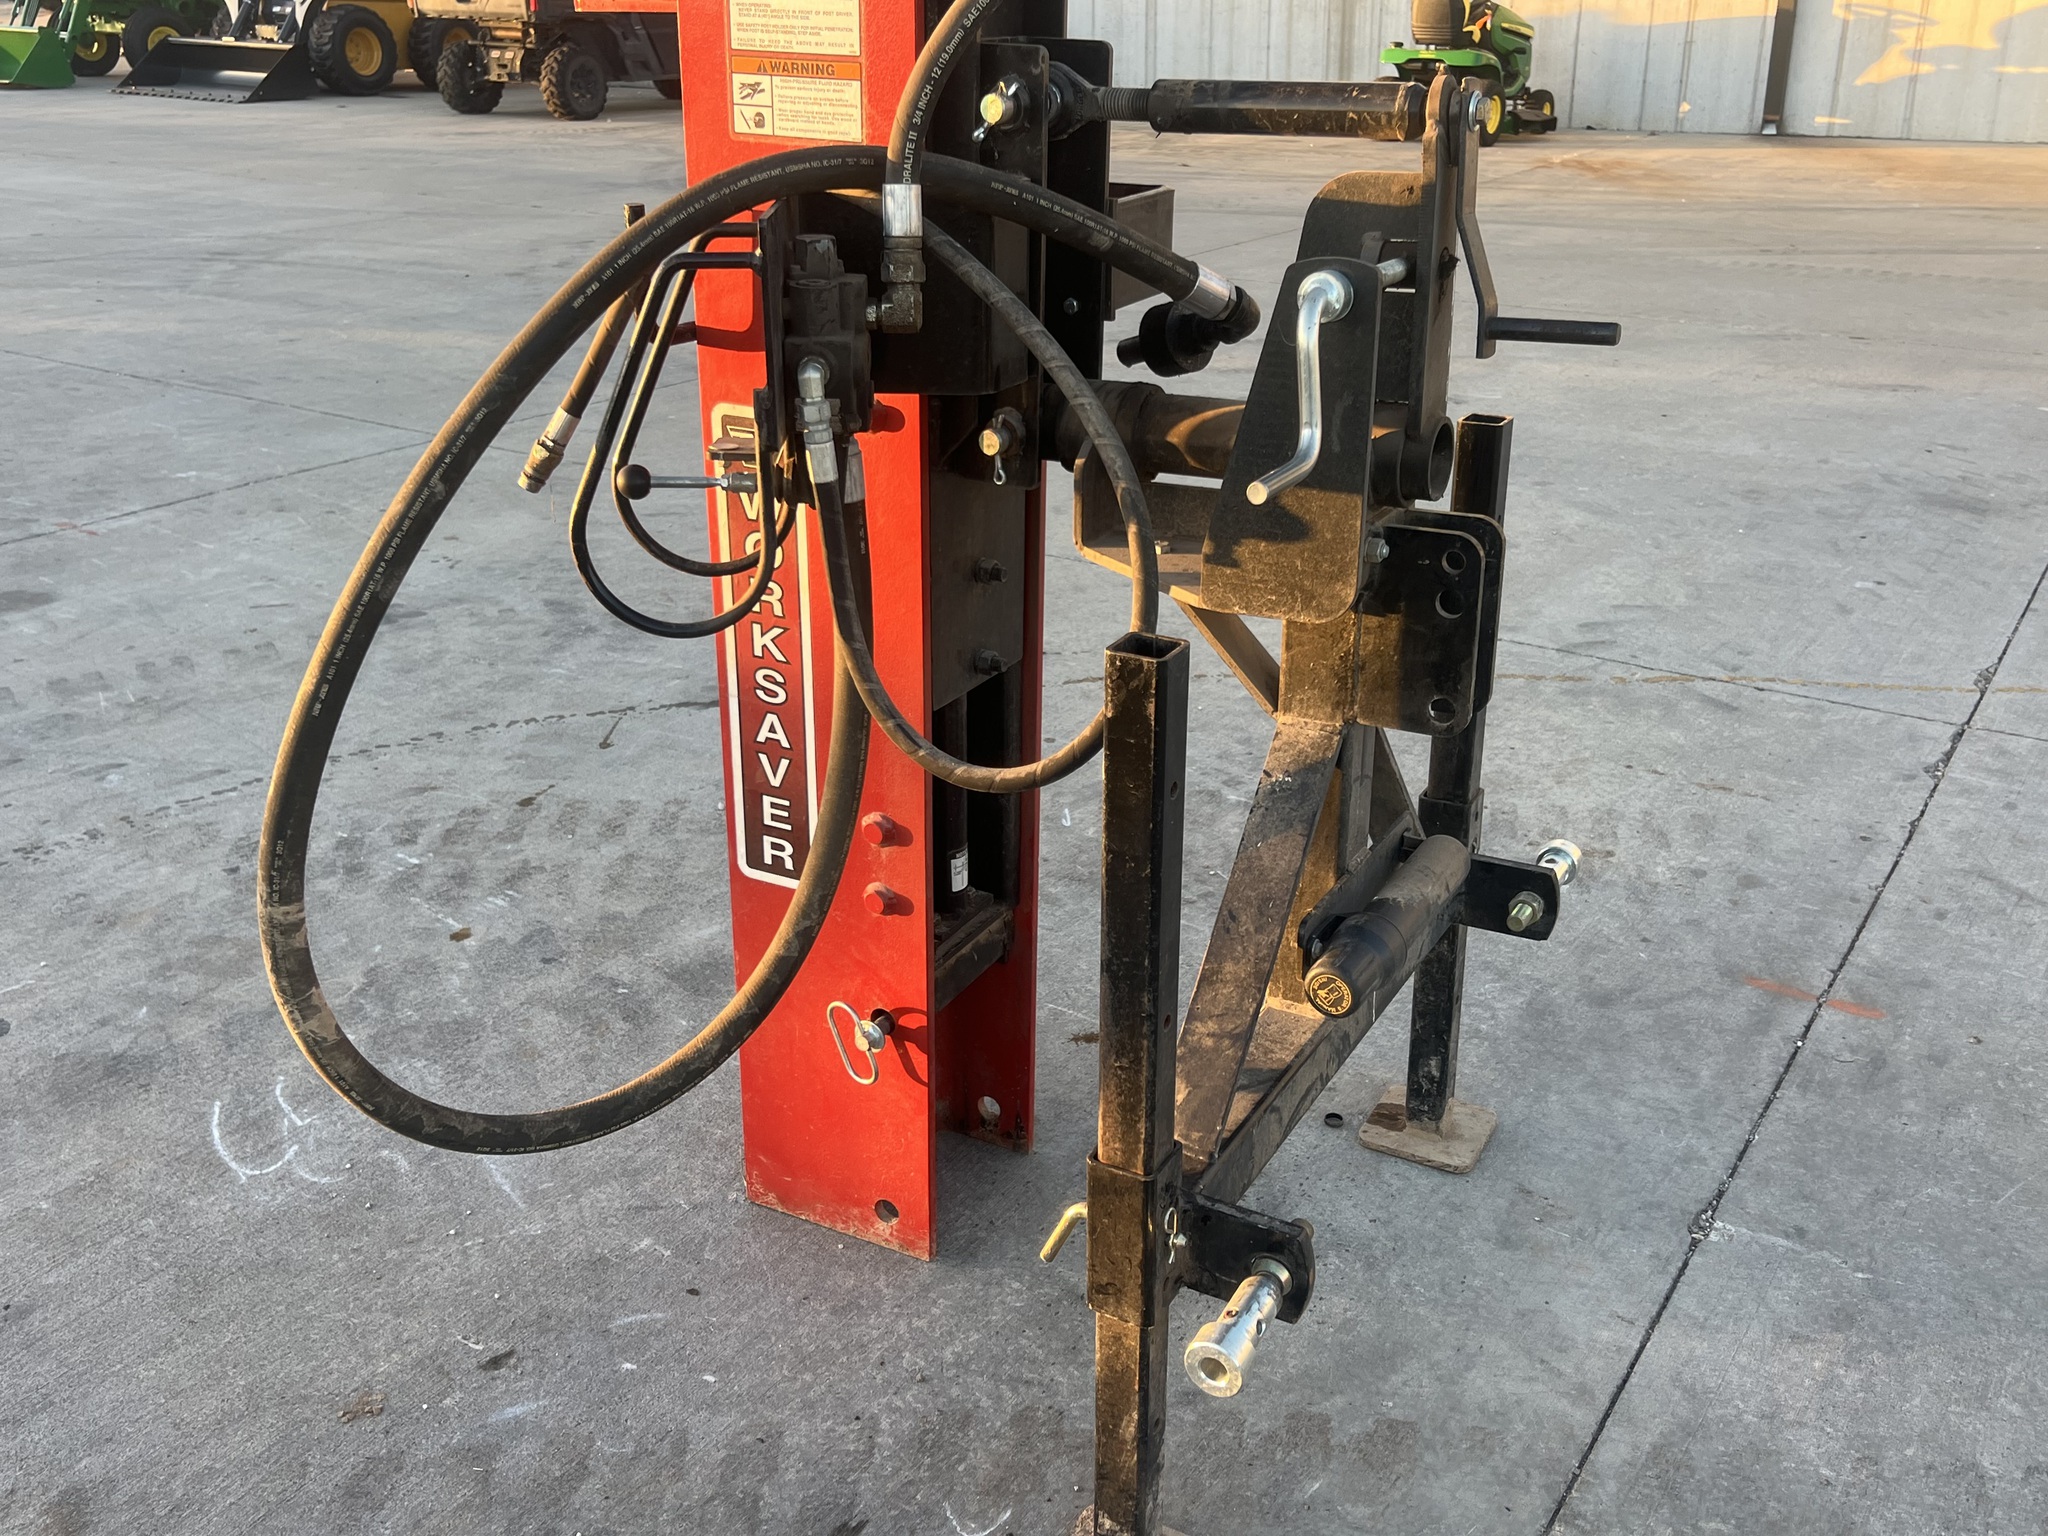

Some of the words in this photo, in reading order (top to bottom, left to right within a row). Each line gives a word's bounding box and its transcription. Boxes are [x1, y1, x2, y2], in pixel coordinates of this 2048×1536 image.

[937, 28, 964, 67] (19.0mm)
[769, 60, 836, 76] WARNING
[931, 67, 942, 78] 12
[917, 84, 933, 110] INCH
[912, 110, 923, 125] 3/4
[602, 268, 614, 280] A101
[617, 252, 632, 266] INCH
[730, 178, 749, 191] FLAME
[326, 666, 336, 680] A101
[335, 644, 346, 658] INCH
[354, 605, 364, 617] SAE
[391, 537, 400, 548] PSI
[396, 518, 412, 538] FLAME
[444, 454, 452, 464] NO.
